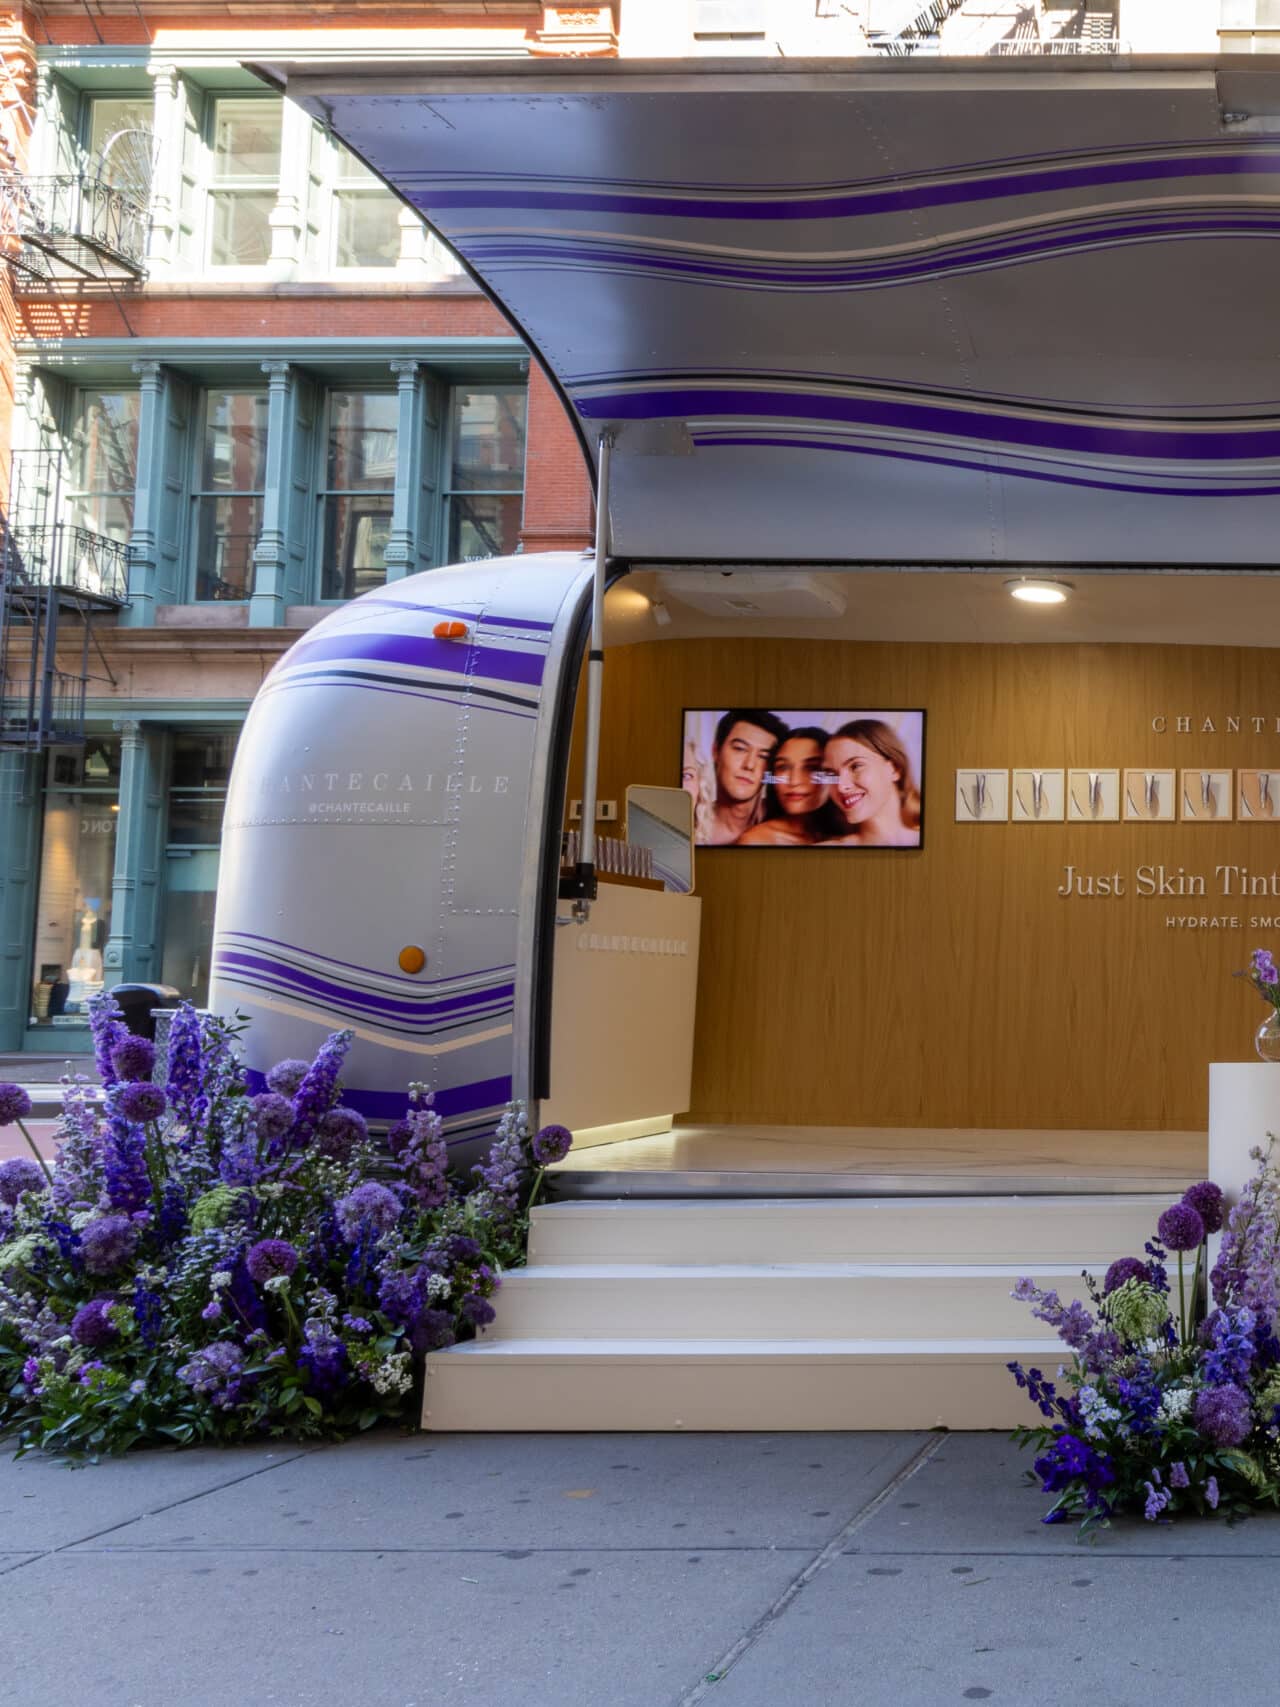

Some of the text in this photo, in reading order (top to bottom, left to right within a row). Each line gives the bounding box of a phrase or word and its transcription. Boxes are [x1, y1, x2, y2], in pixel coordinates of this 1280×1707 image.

[308, 802, 411, 814] @CHANTECAILLE
[1057, 864, 1125, 896] Just
[1136, 864, 1206, 896] Skin
[1166, 916, 1243, 928] HYDRATE.
